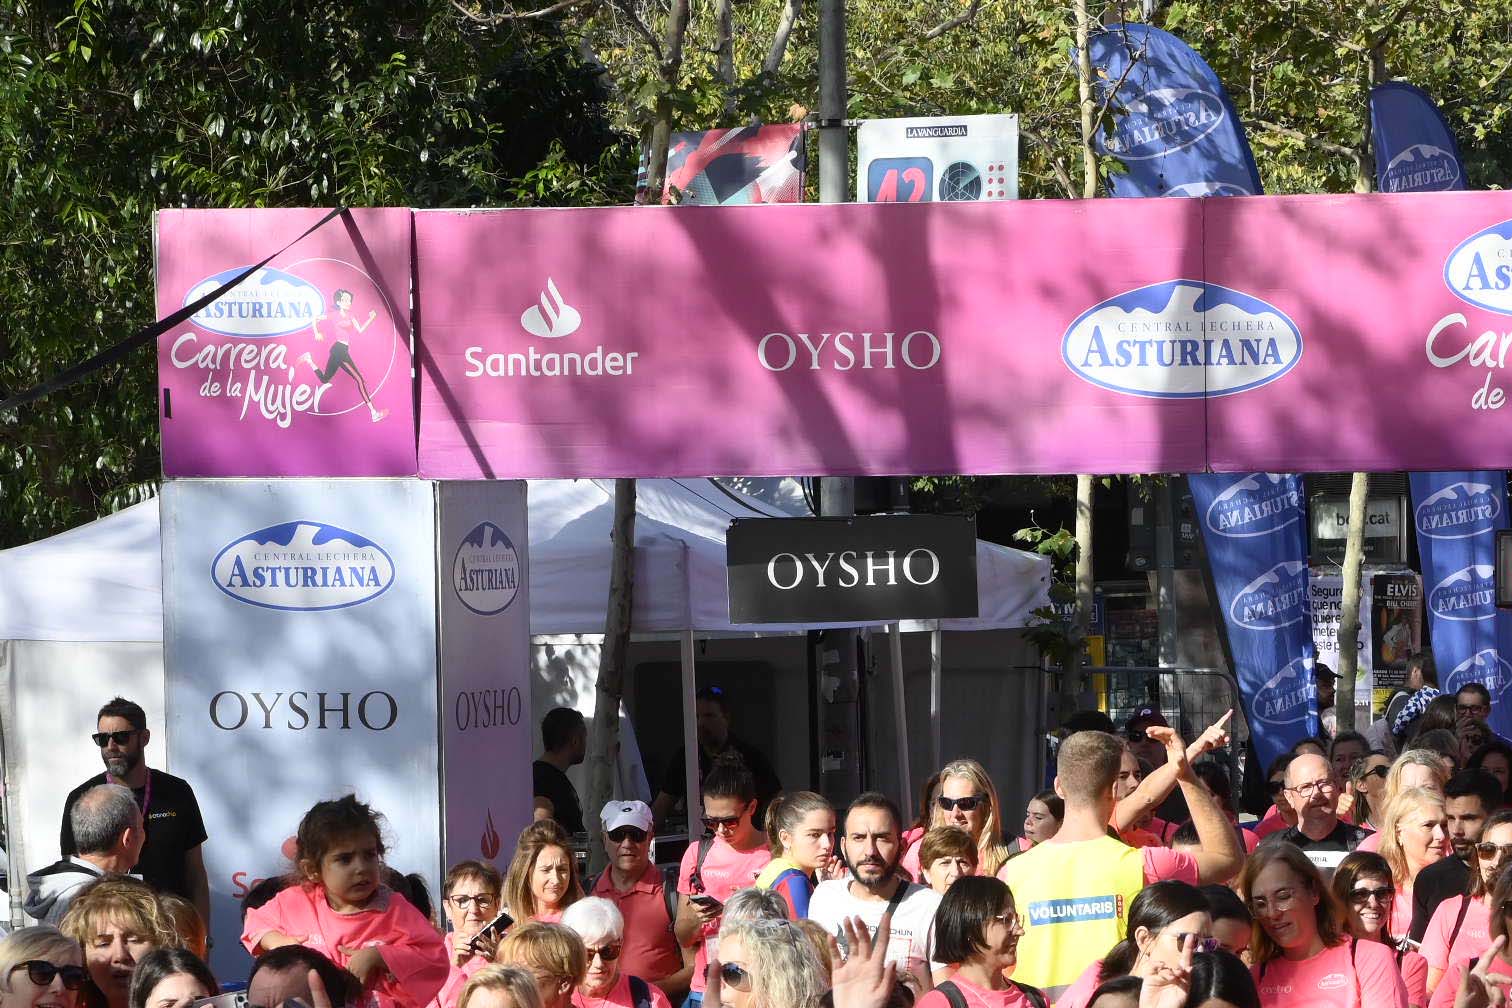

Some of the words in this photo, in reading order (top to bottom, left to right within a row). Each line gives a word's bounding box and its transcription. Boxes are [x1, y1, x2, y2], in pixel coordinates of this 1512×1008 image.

[1118, 321, 1192, 332] CENTRAL
[1200, 321, 1275, 331] LECHERA
[171, 332, 287, 369] Carrera
[465, 345, 638, 377] Santander
[758, 331, 941, 373] OYSHO
[1080, 325, 1283, 367] ASTURIANA
[200, 371, 221, 397] de
[226, 371, 242, 398] la
[240, 367, 332, 428] Mujer
[1471, 371, 1506, 410] de
[226, 554, 382, 588] ASTURIANA
[254, 552, 308, 561] CENTRAL
[318, 552, 375, 561] LECHERA
[458, 557, 516, 592] ASTURIANA
[767, 548, 940, 590] OYSHO
[1386, 584, 1417, 596] ELVIS
[209, 691, 398, 730] OYSHO
[455, 686, 521, 731] OYSHO
[1031, 902, 1113, 920] VOLUNTARIS
